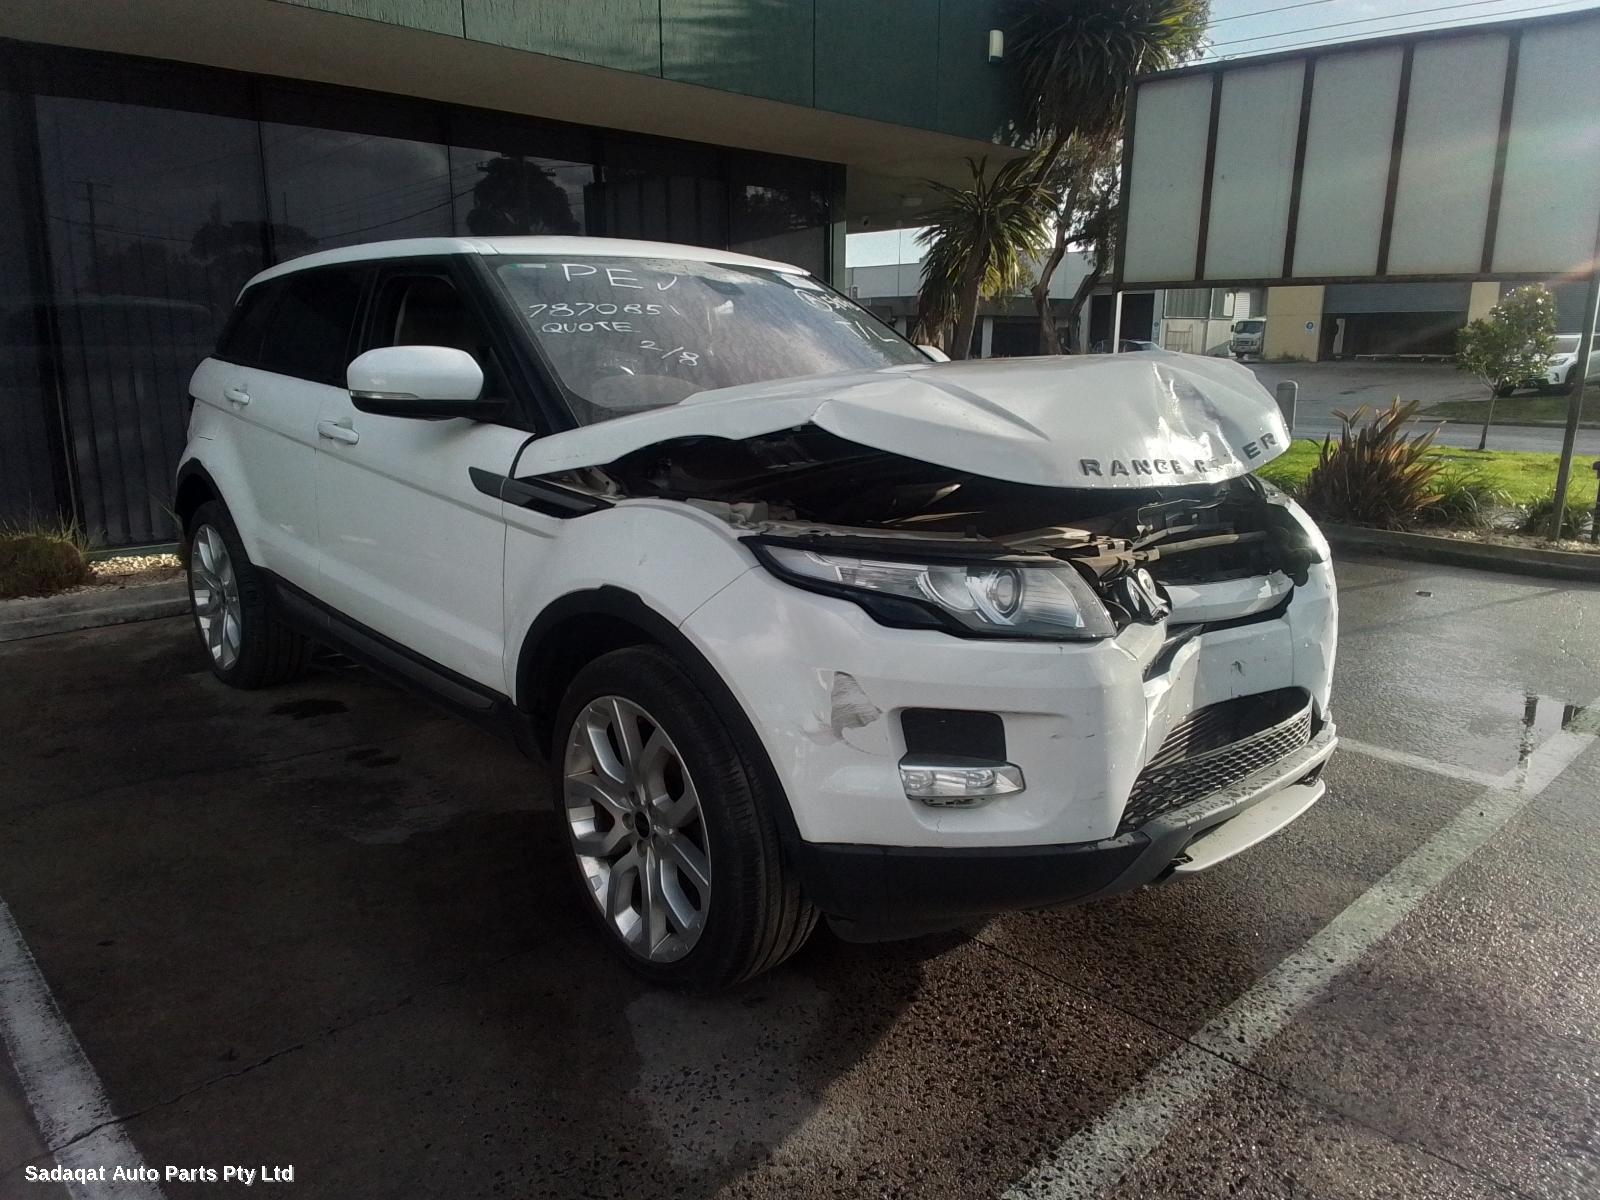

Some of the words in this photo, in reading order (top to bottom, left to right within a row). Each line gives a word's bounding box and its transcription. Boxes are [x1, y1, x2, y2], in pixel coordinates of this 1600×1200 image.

[541, 321, 641, 334] QUOTE
[639, 340, 700, 367] 2/8
[1079, 458, 1185, 477] RANGE
